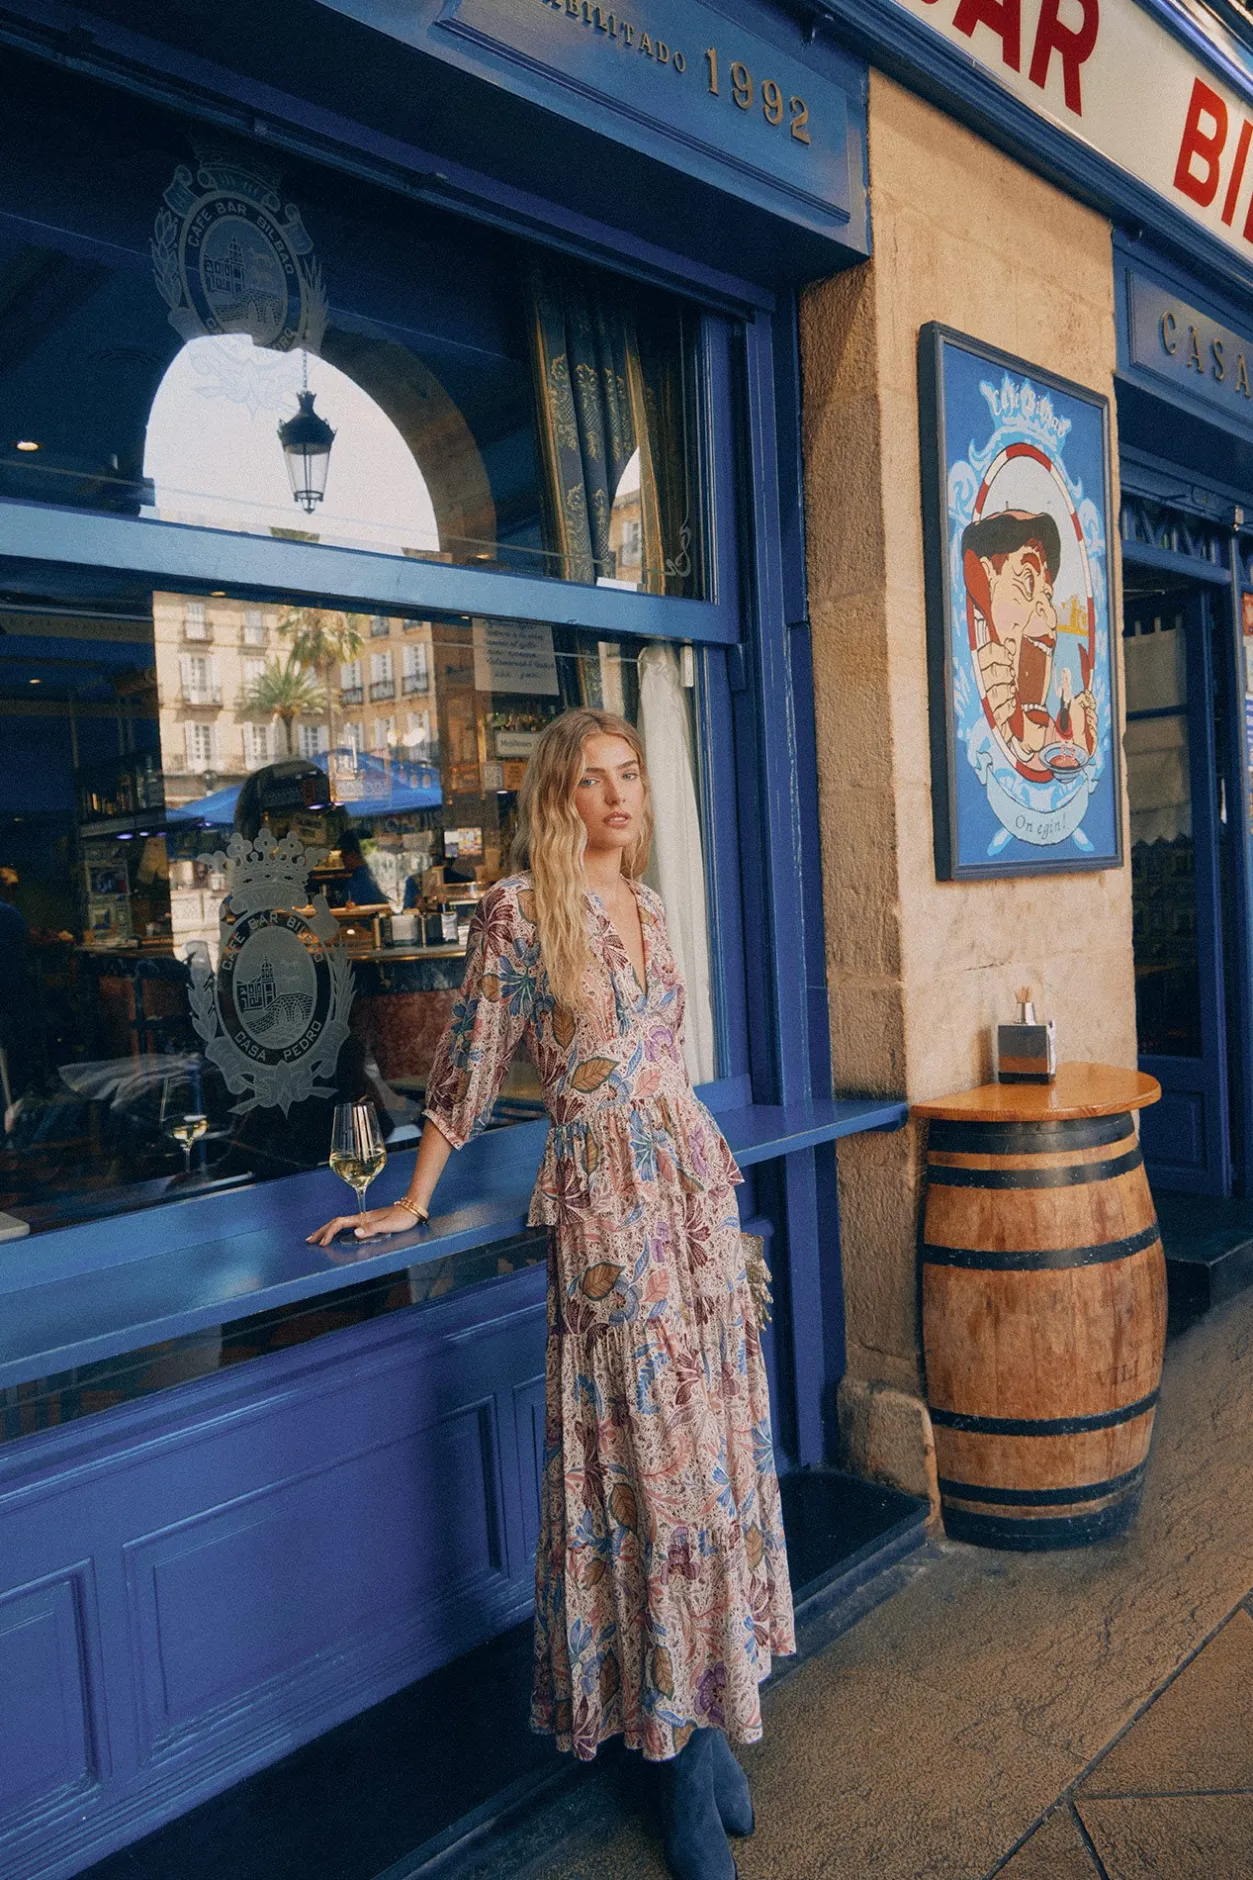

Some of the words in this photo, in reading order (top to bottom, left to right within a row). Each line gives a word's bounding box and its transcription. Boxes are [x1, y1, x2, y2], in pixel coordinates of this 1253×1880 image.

[543, 0, 686, 73] BILITADO
[704, 47, 811, 145] 1992
[921, 0, 1100, 117] AR
[1173, 77, 1253, 244] BI
[188, 209, 213, 247] CAFE
[215, 201, 247, 216] BAR
[257, 216, 295, 274] BILBAO
[1161, 311, 1251, 398] CASA
[1015, 814, 1033, 833] On
[222, 932, 246, 970] CAFE
[248, 912, 279, 930] BAR
[234, 1031, 267, 1061] CASA
[283, 1020, 322, 1061] PEDRO
